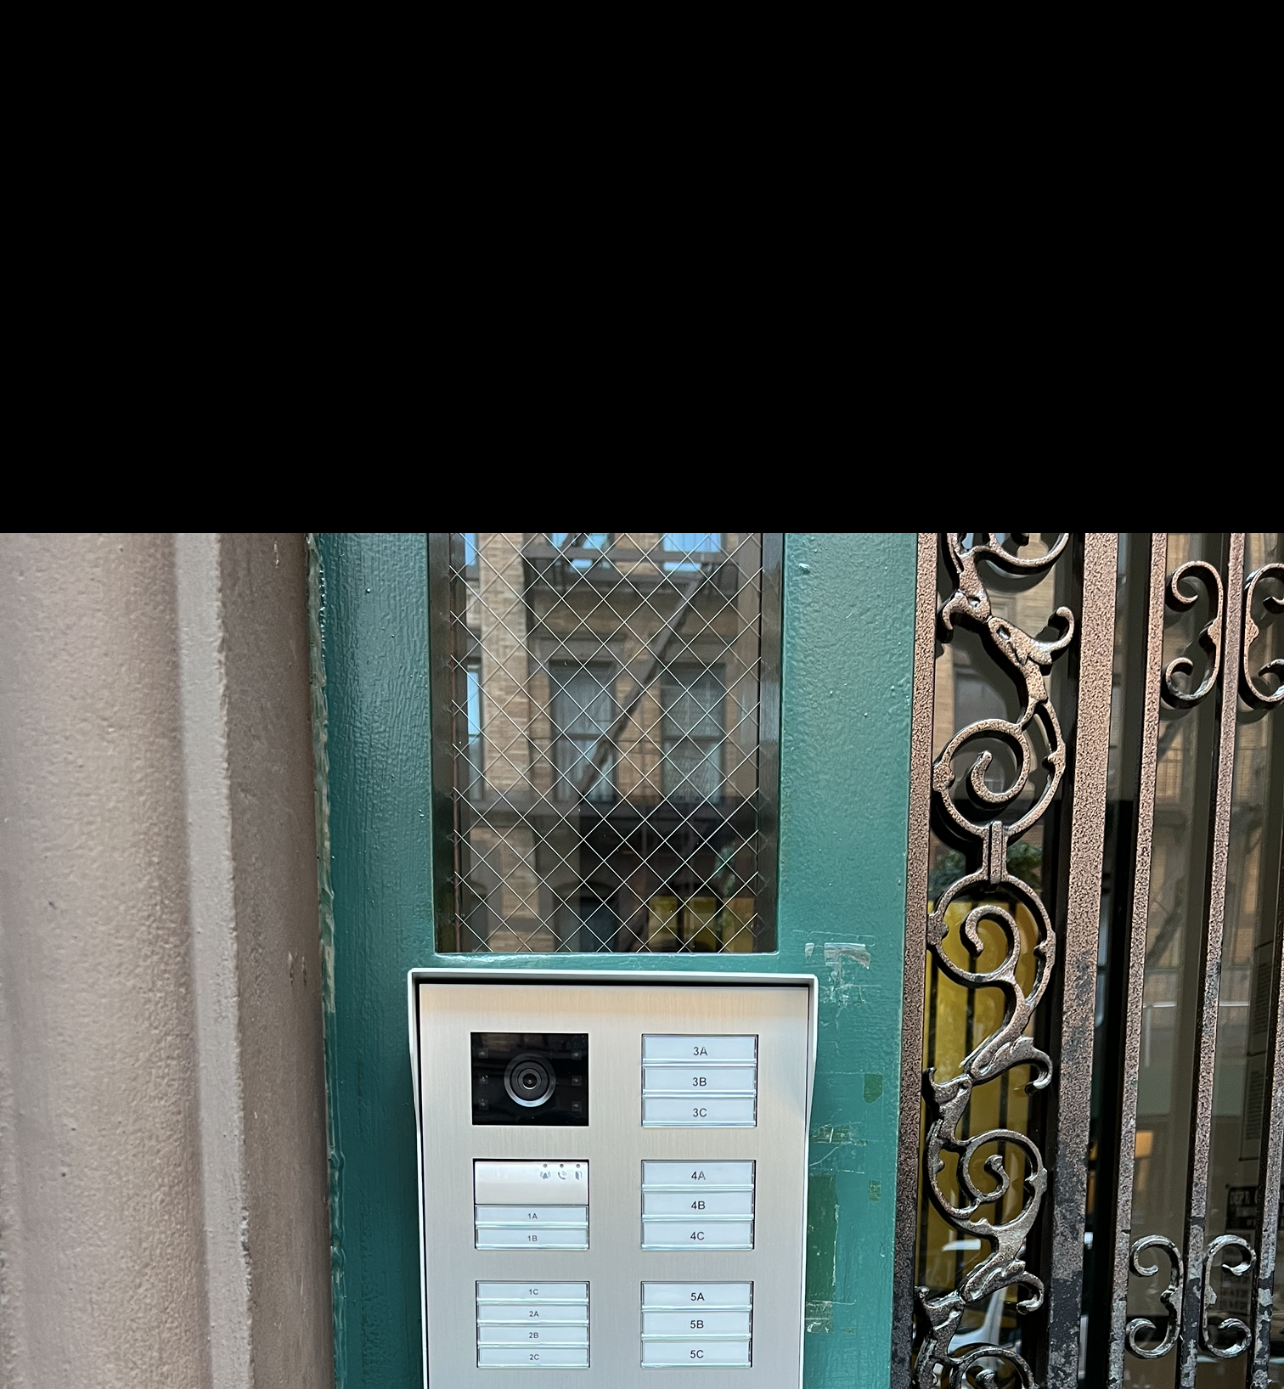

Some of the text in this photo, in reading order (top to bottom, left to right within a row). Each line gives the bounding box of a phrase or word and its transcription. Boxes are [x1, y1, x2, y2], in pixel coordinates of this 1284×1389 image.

[693, 1046, 709, 1057] 3A
[692, 1076, 708, 1087] 3B
[692, 1107, 708, 1118] 3C
[690, 1170, 707, 1181] 4A
[690, 1200, 706, 1211] 4B
[527, 1212, 538, 1220] 1A
[527, 1234, 538, 1242] 1B
[689, 1231, 705, 1241] 4C
[528, 1288, 539, 1296] 1C
[690, 1291, 706, 1302] 5A
[529, 1310, 540, 1318] 2A
[689, 1319, 705, 1330] 5B
[528, 1331, 539, 1339] 2B
[529, 1353, 540, 1361] 2C
[689, 1349, 704, 1360] 5C
